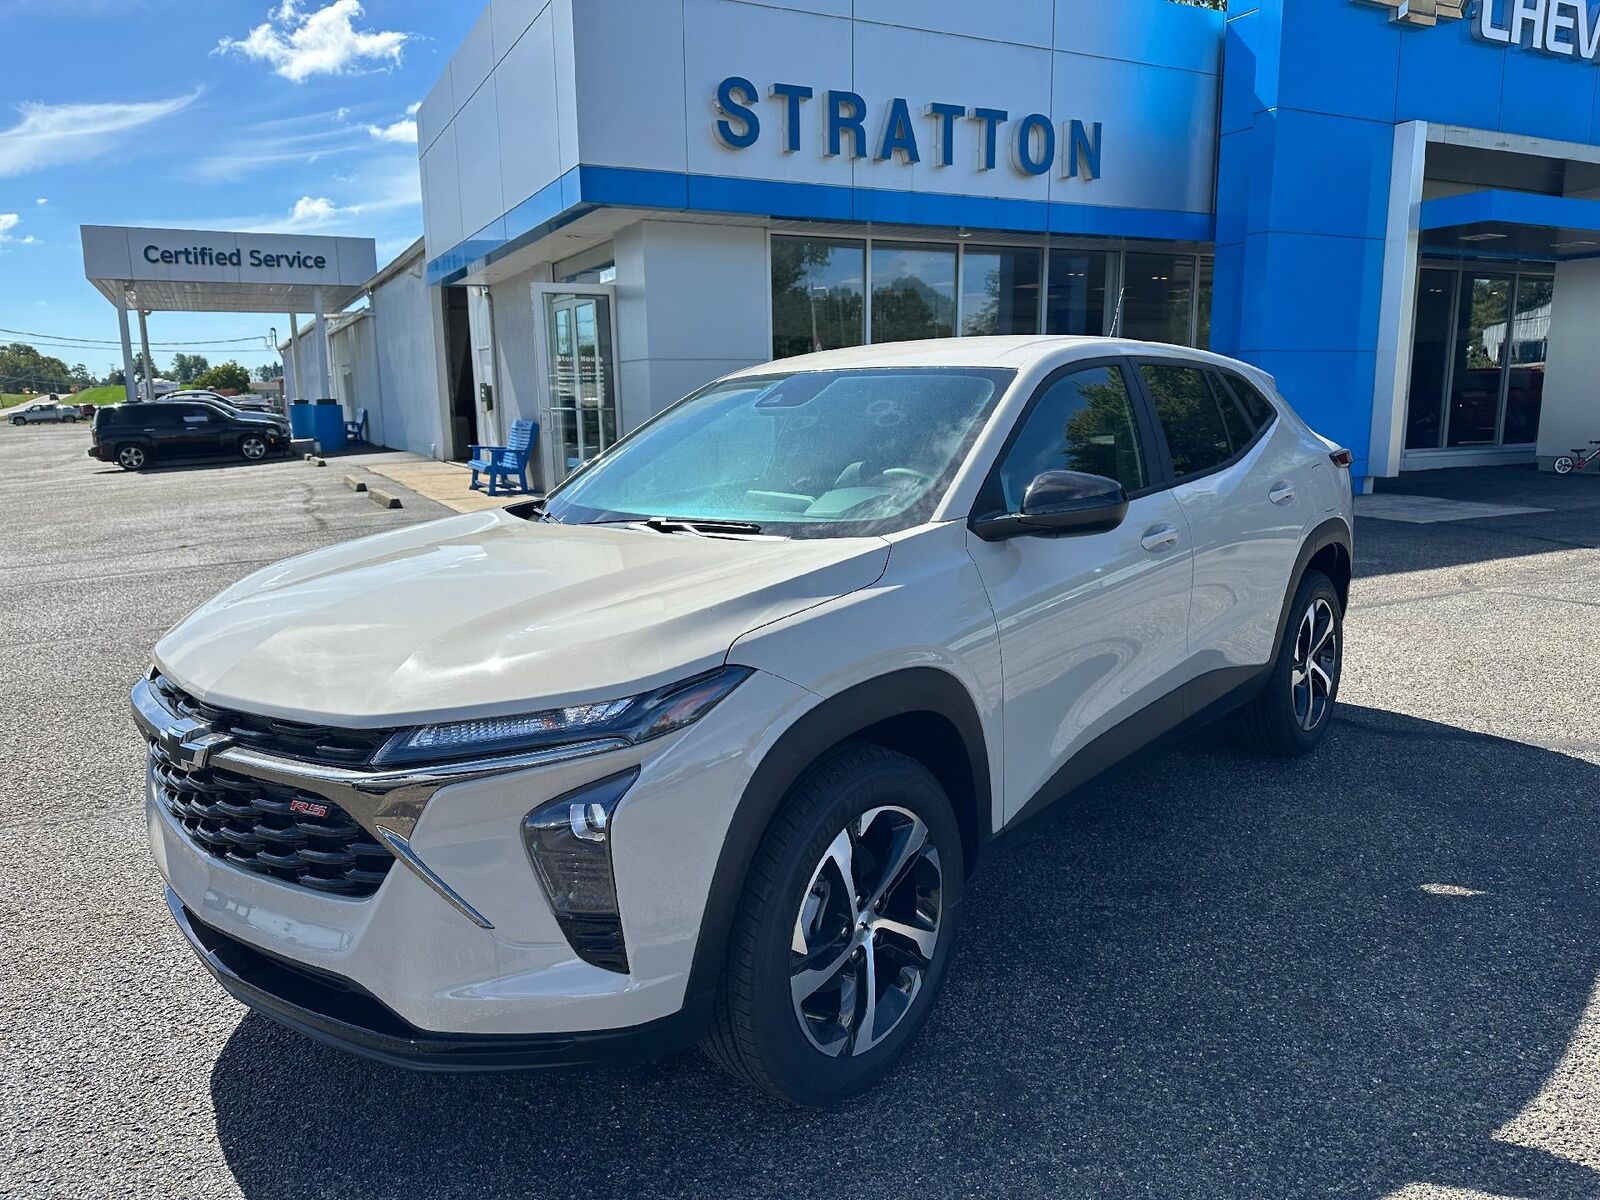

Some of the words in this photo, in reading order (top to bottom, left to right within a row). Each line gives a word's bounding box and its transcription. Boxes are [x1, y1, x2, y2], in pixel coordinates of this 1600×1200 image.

[713, 76, 1103, 181] STRATTON
[143, 245, 242, 267] Certified
[249, 249, 326, 269] Service
[290, 800, 328, 817] RS
